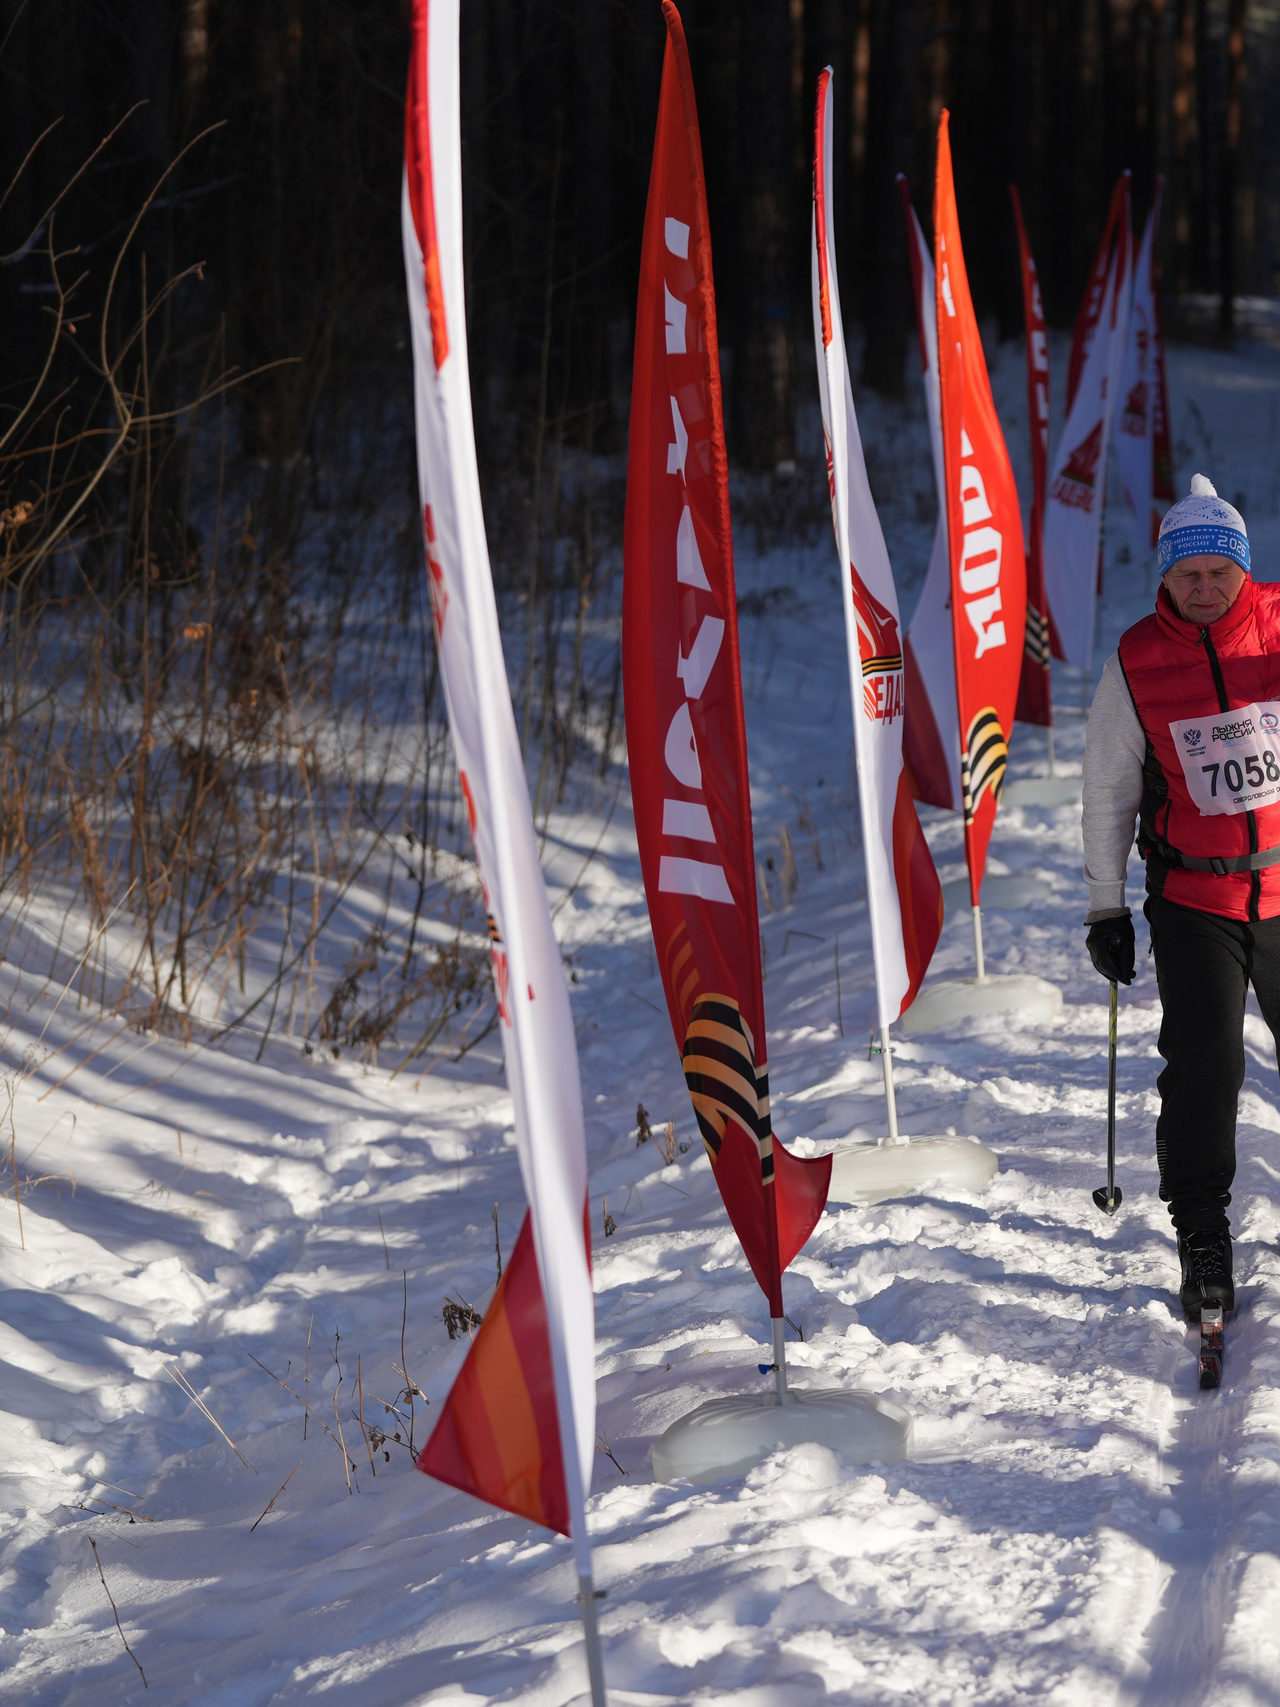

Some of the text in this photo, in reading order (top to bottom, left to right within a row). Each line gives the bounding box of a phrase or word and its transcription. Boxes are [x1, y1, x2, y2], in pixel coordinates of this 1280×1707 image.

[1173, 534, 1215, 546] МИНСПОРТ
[1178, 540, 1210, 550] РОССИИ
[1217, 535, 1246, 557] 2025
[1211, 718, 1253, 735] ЛЫЖНЯ
[1211, 726, 1256, 742] РОССИИ
[1202, 750, 1280, 797] 7058
